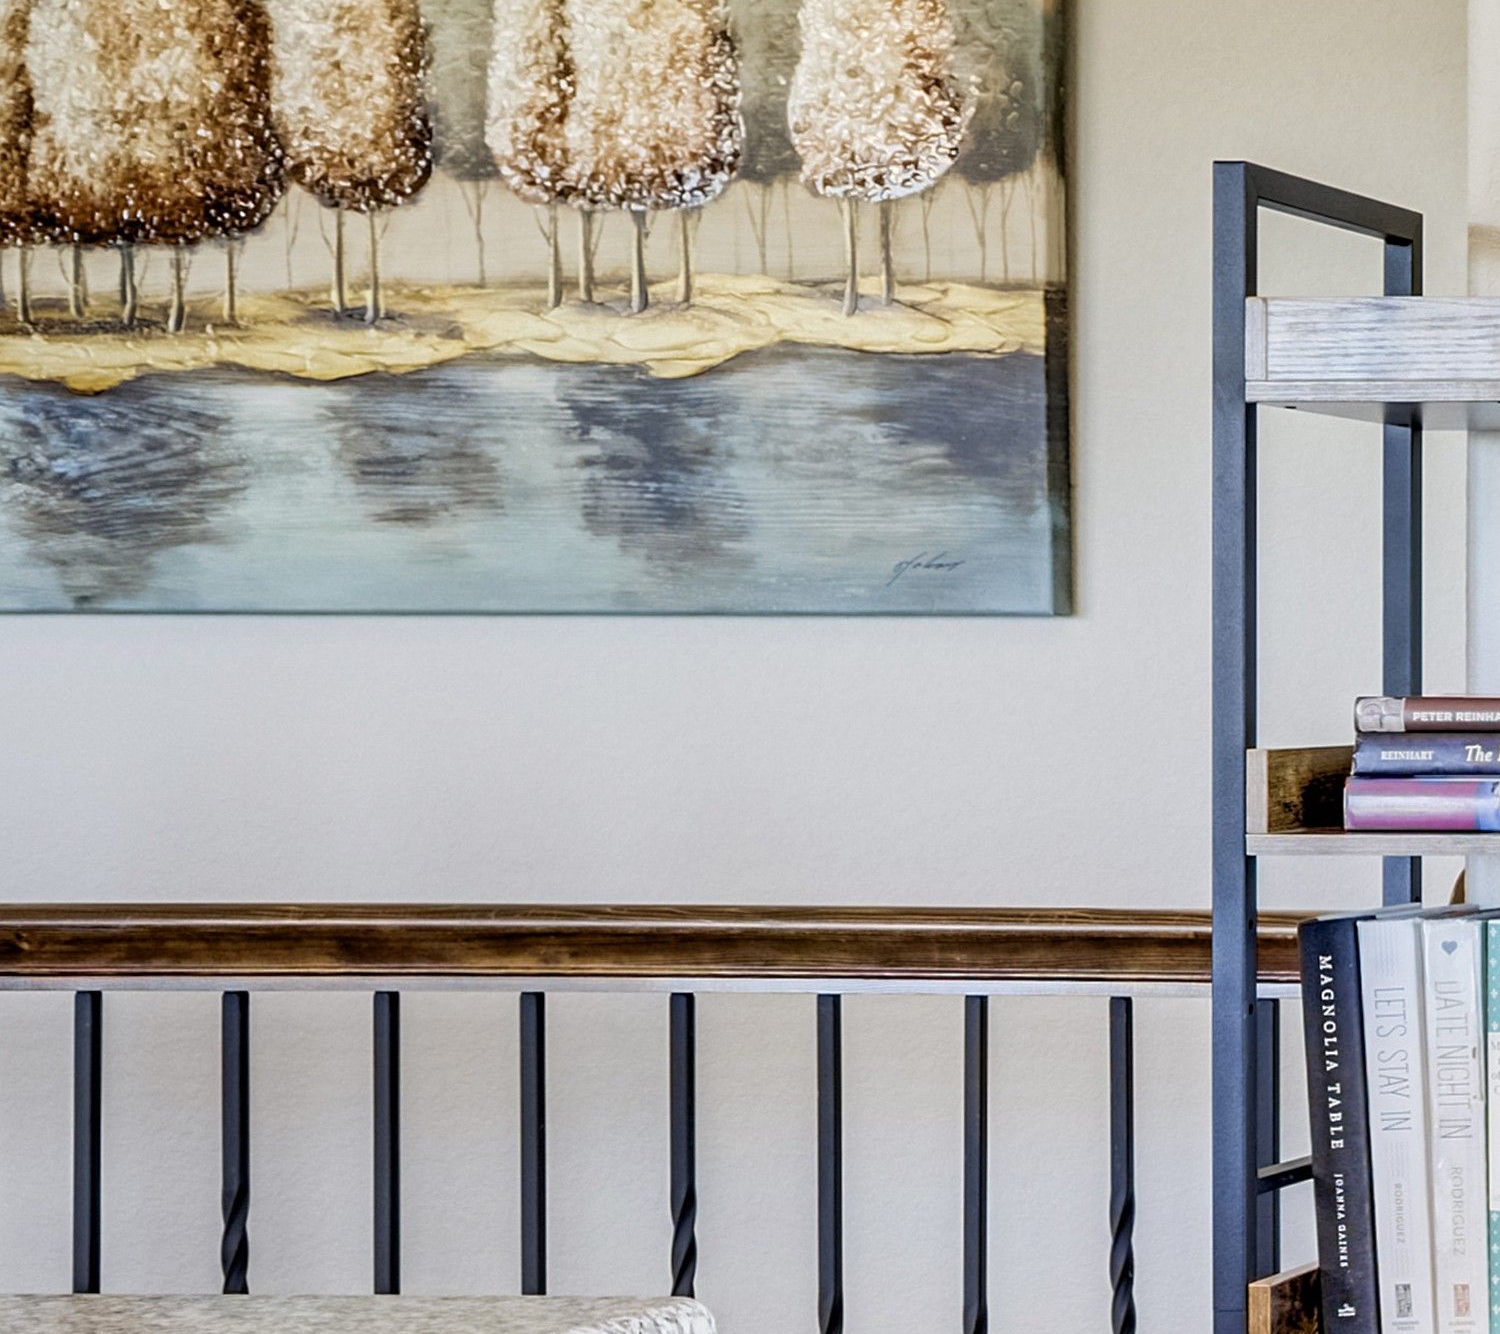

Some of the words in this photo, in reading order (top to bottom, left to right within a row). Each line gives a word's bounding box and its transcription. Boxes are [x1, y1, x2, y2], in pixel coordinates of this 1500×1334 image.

[1412, 711, 1453, 722] PETER
[1380, 750, 1435, 761] REINHART
[1464, 744, 1493, 762] The
[1318, 955, 1339, 1072] MAGNOLIA
[1434, 980, 1465, 1038] DATE
[1377, 1049, 1410, 1099] STAY
[1436, 1045, 1471, 1107] NIGHT
[1327, 1082, 1344, 1149] TABLE
[1380, 1110, 1412, 1132] IN
[1440, 1117, 1472, 1140] IN
[1334, 1173, 1346, 1220] JOANNA
[1394, 1182, 1406, 1244] RODRIGUEZ
[1450, 1166, 1466, 1257] RODRIGUEZ
[1337, 1223, 1349, 1268] GAINES
